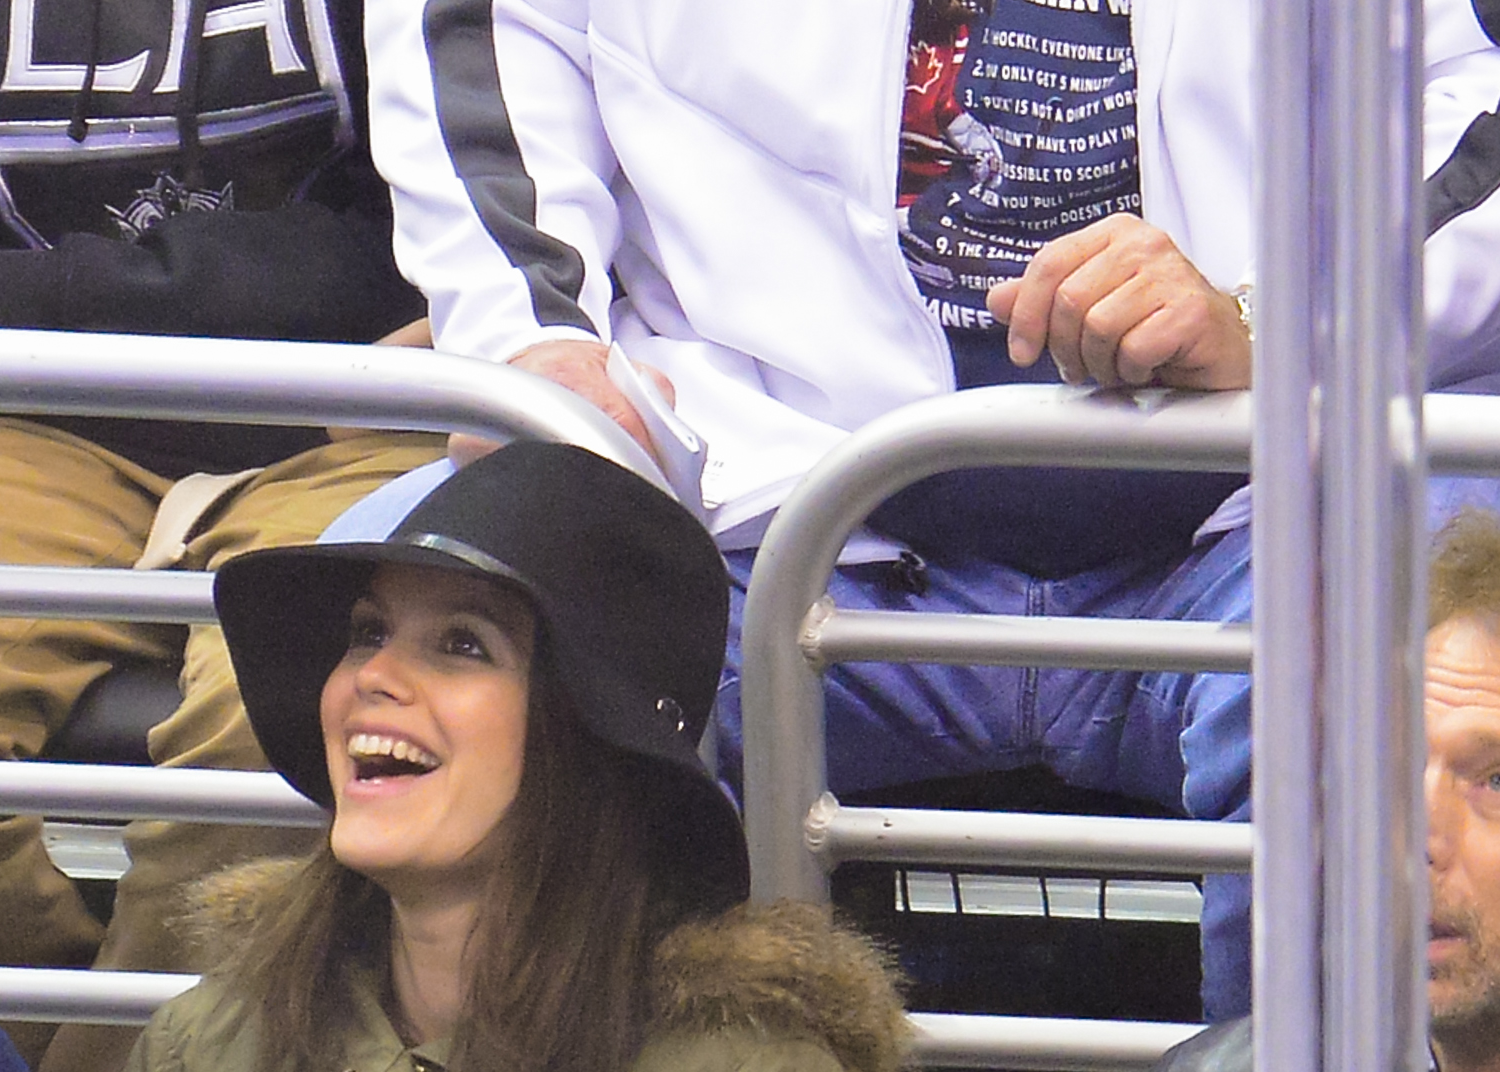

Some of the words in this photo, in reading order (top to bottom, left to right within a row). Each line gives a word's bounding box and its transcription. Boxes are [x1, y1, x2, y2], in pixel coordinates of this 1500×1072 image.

[1041, 38, 1104, 61] EVERYONE
[1001, 64, 1034, 83] ONLY
[1035, 70, 1057, 88] GET
[1014, 98, 1029, 116] IS
[1031, 101, 1053, 121] NOT
[1055, 107, 1065, 123] A
[1066, 100, 1100, 123] DIRTY
[1036, 134, 1067, 153] HAVE
[1068, 136, 1087, 153] TO
[1088, 128, 1118, 149] PLAY
[1122, 124, 1135, 139] IN
[1054, 167, 1073, 183] TO
[1077, 161, 1116, 181] SCORE
[1002, 195, 1028, 209] YOU
[1060, 199, 1113, 224] DOESN'T
[936, 236, 953, 255] 9.
[957, 242, 983, 258] THE
